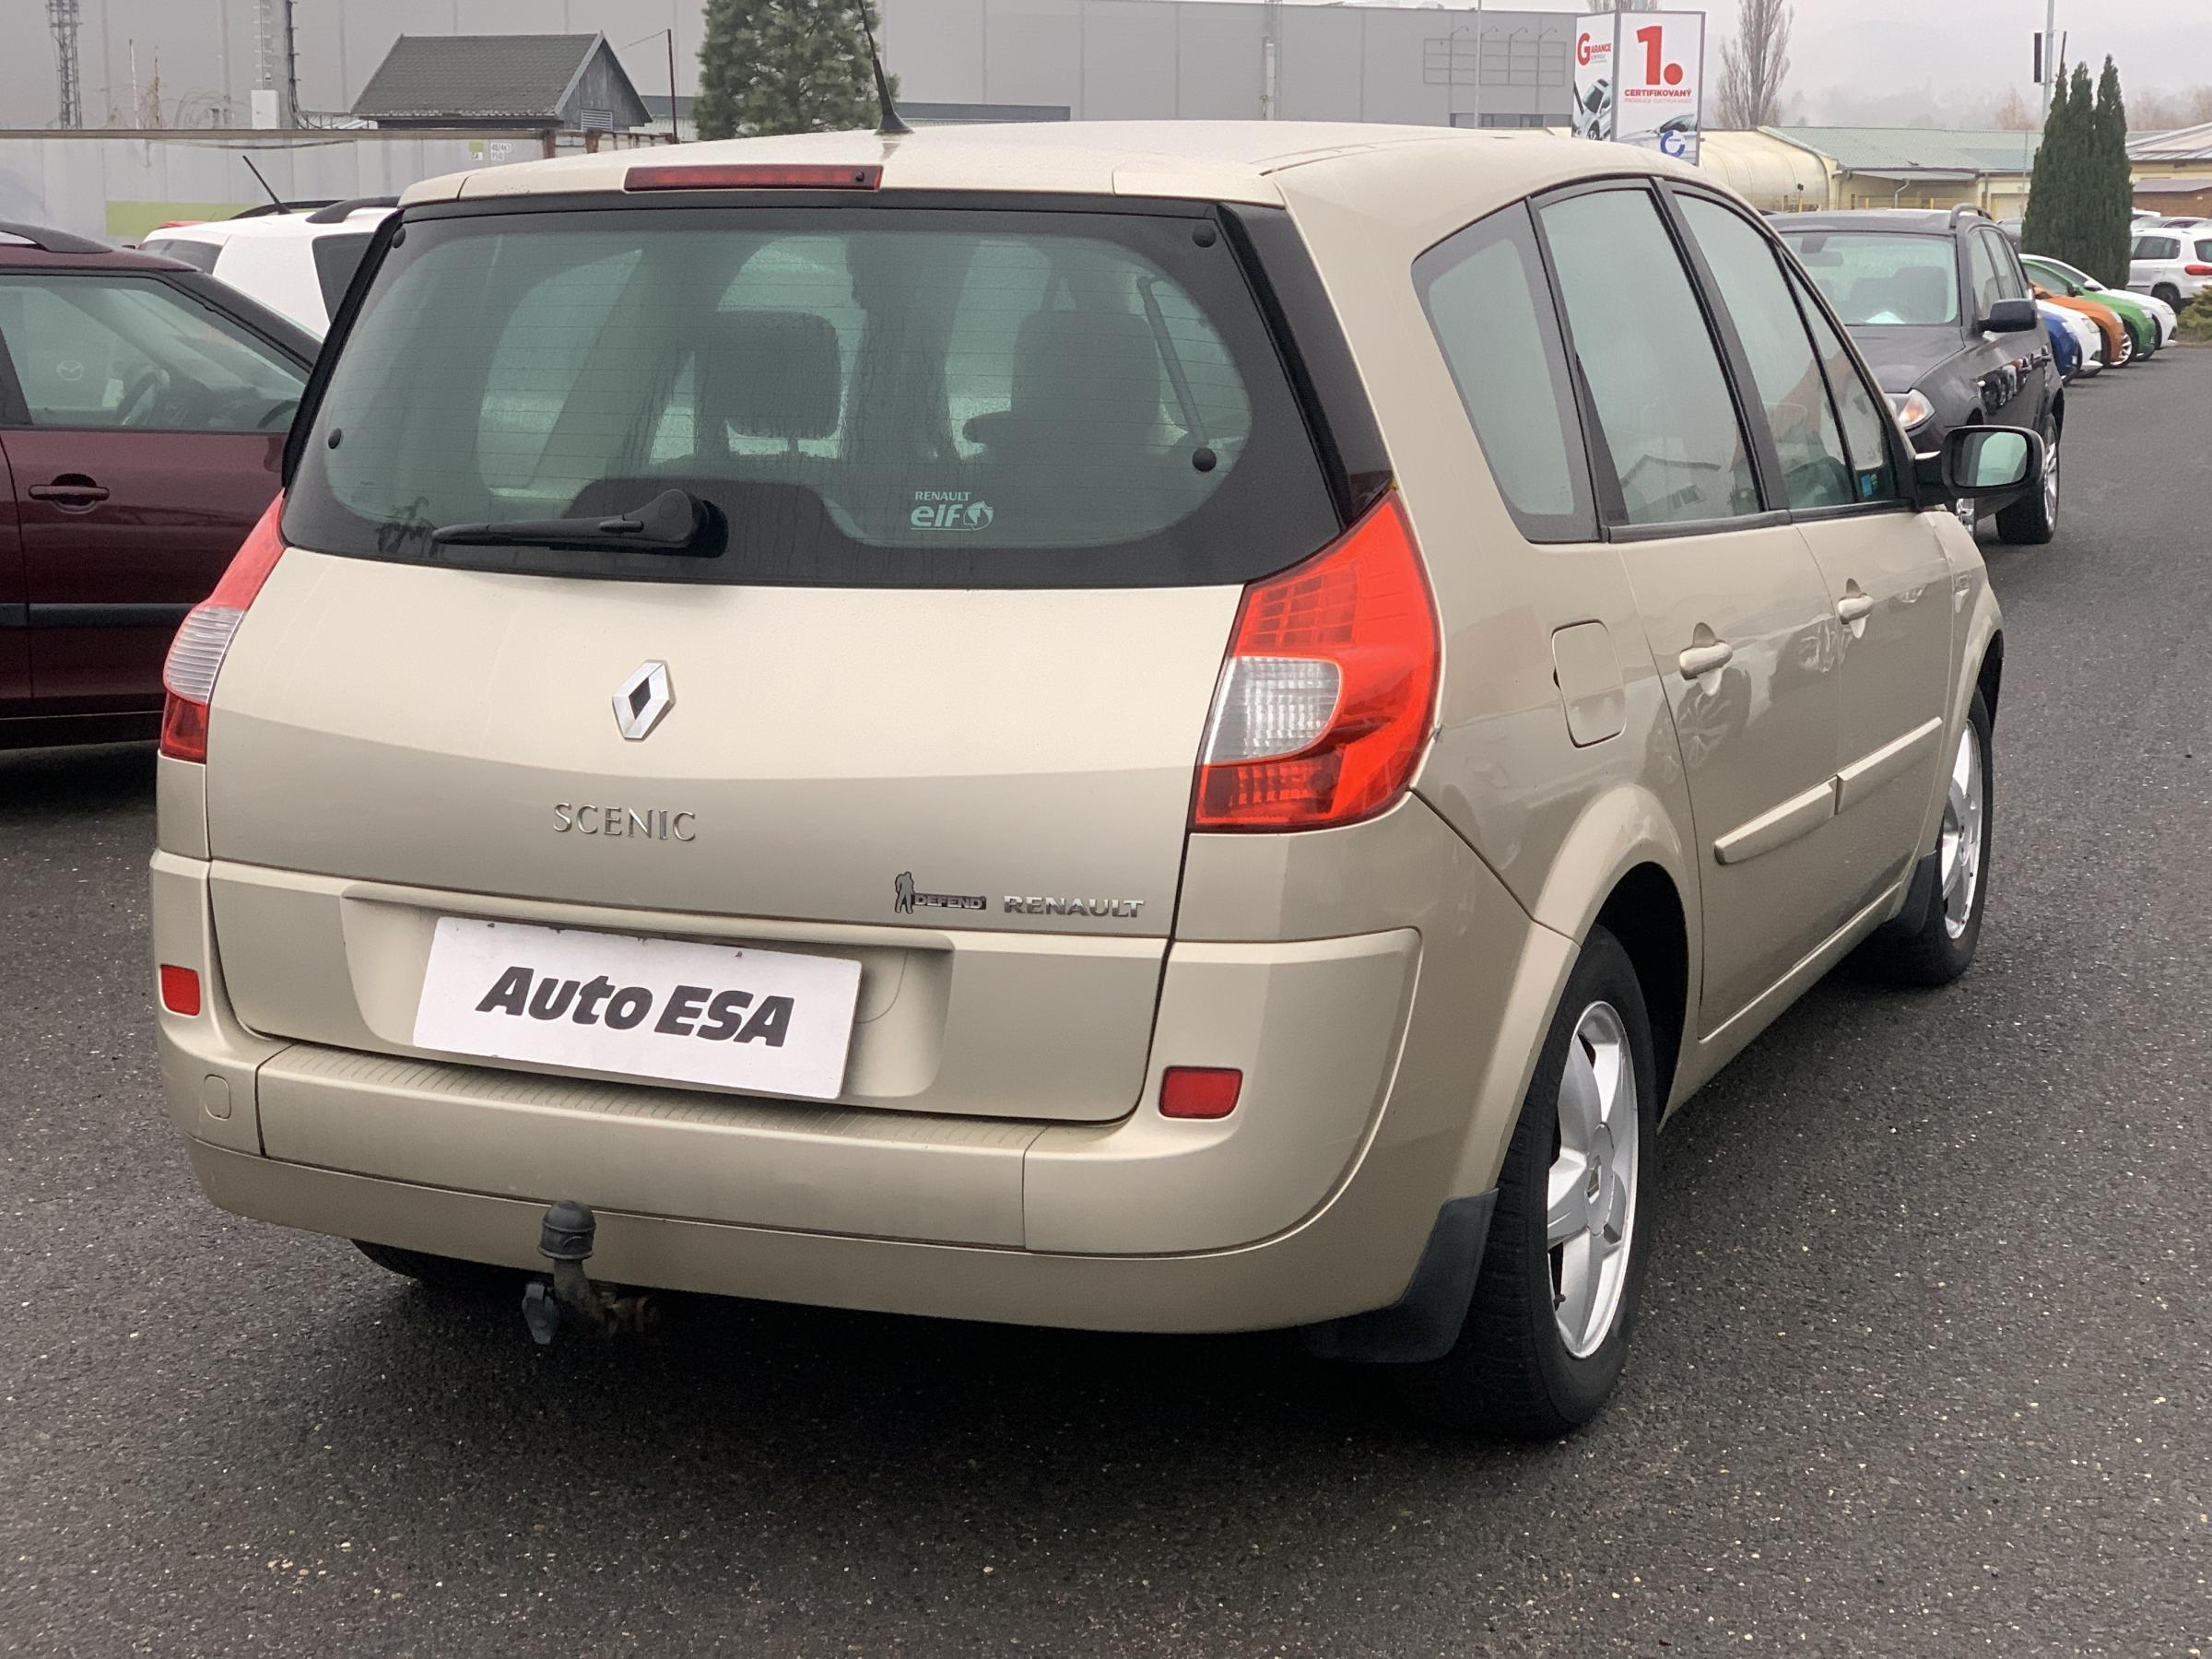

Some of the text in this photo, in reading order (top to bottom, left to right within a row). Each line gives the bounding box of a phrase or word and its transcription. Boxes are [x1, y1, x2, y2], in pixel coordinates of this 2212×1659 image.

[1577, 32, 1612, 66] GARANCE
[1636, 25, 1684, 86] 1.
[1624, 88, 1692, 97] CERTIFIKOVANÝ
[914, 491, 971, 501] RENAULT
[911, 503, 963, 527] elf
[553, 802, 696, 842] SCENIC
[913, 894, 983, 910] DEFEND
[1003, 894, 1145, 918] RENAULT
[475, 965, 794, 1048] Auto ESA
